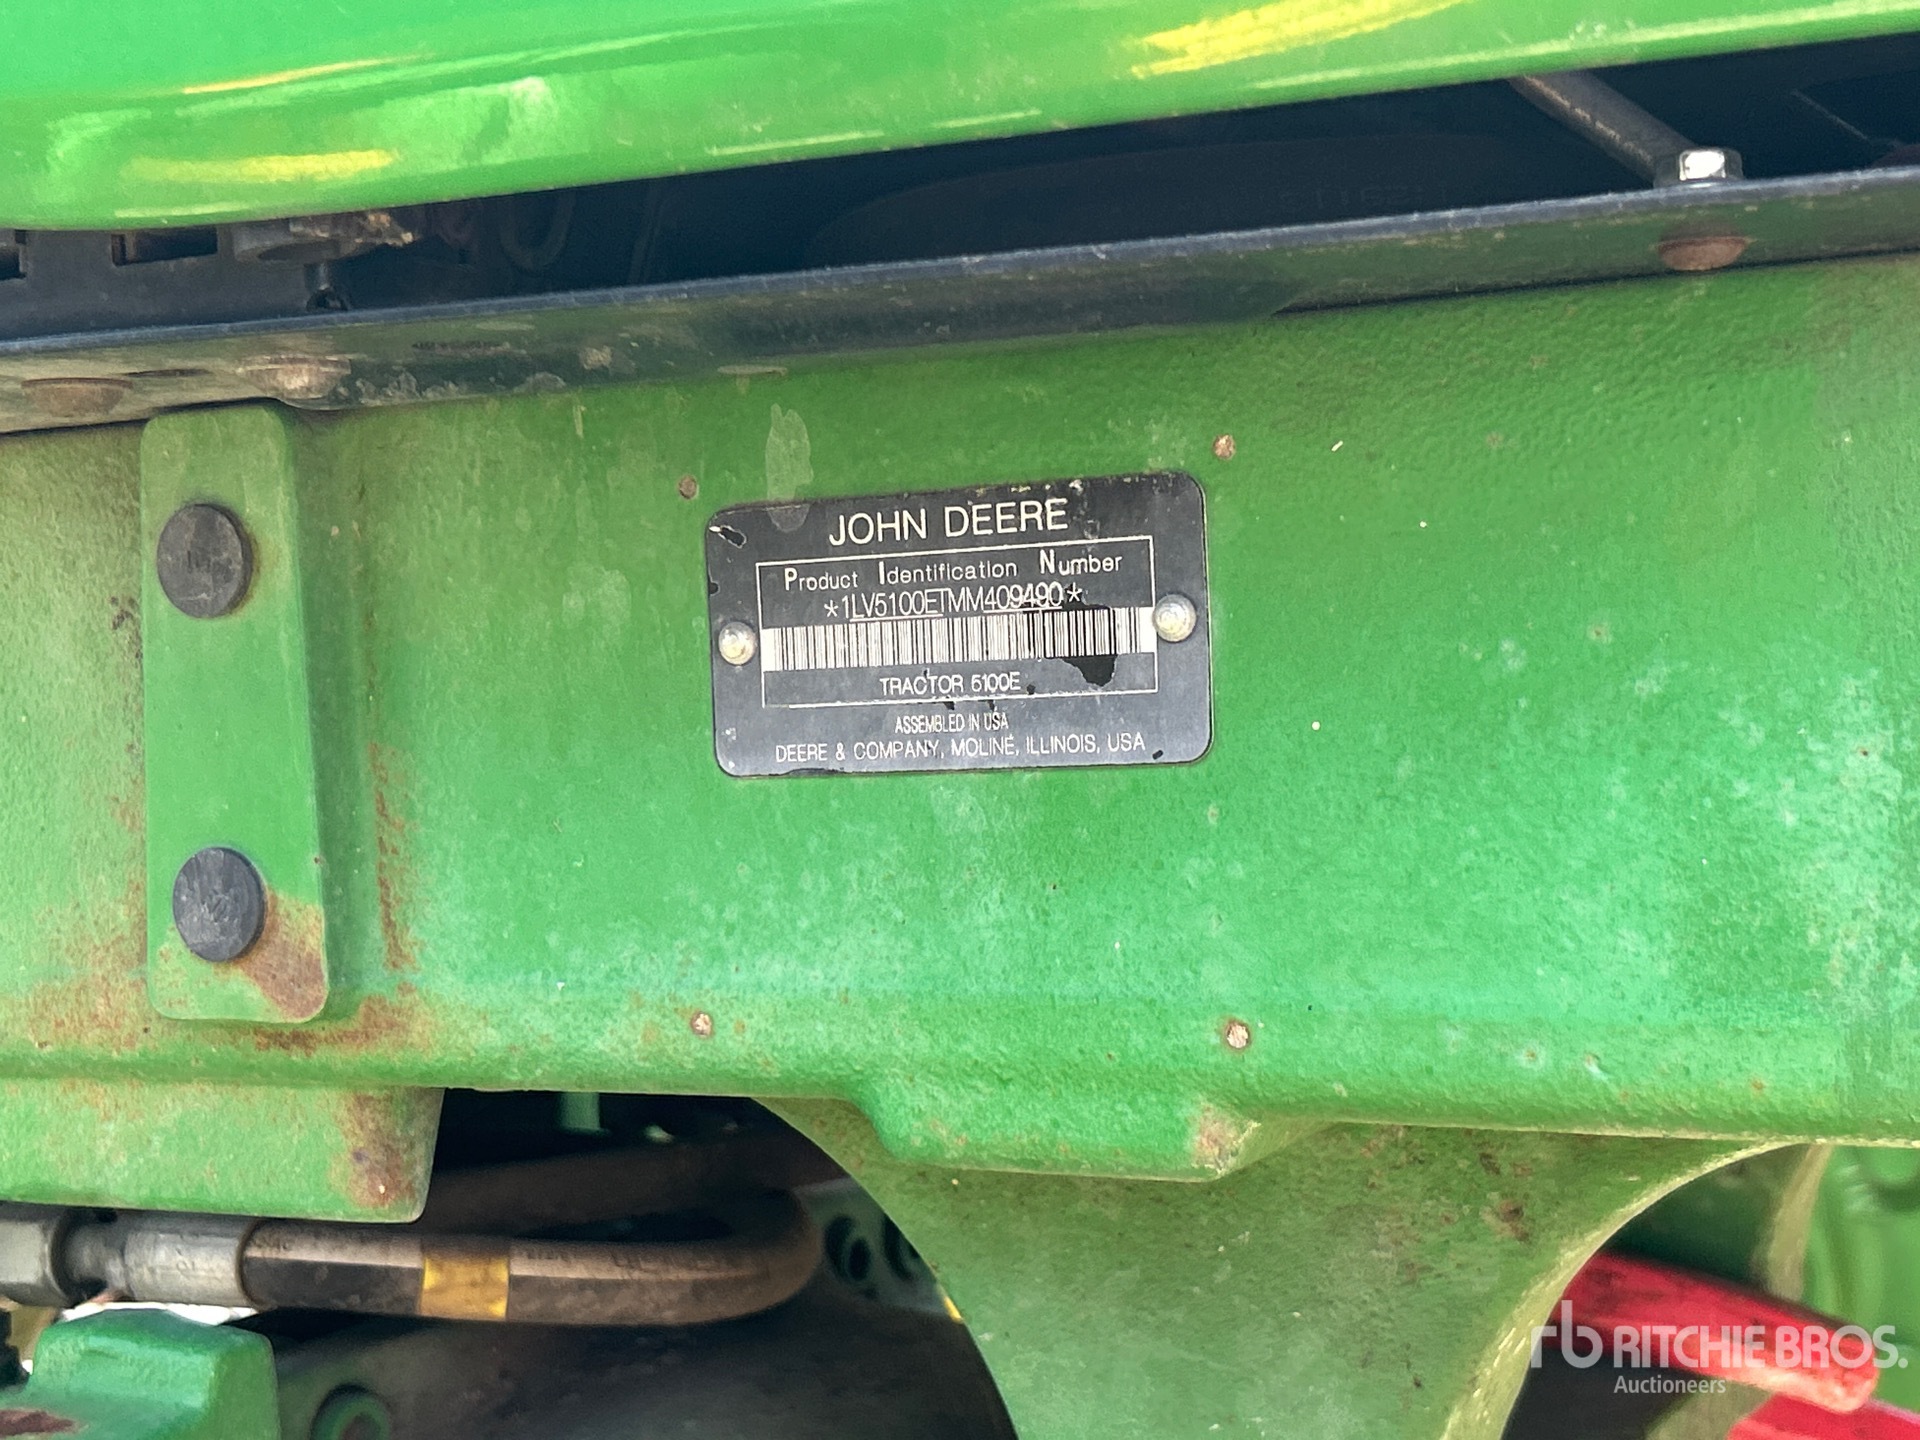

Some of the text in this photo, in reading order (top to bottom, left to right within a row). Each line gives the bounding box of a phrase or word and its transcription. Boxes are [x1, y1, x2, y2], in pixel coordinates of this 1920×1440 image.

[828, 498, 1069, 546] JOHN DEERE
[784, 549, 1123, 591] Product Identification Number
[879, 674, 964, 695] TRACTOR
[895, 711, 1009, 734] ASSEMBLED IN USA
[775, 732, 1146, 762] DEERE & COMPANY, MOLINE, ILLINOIS, USA
